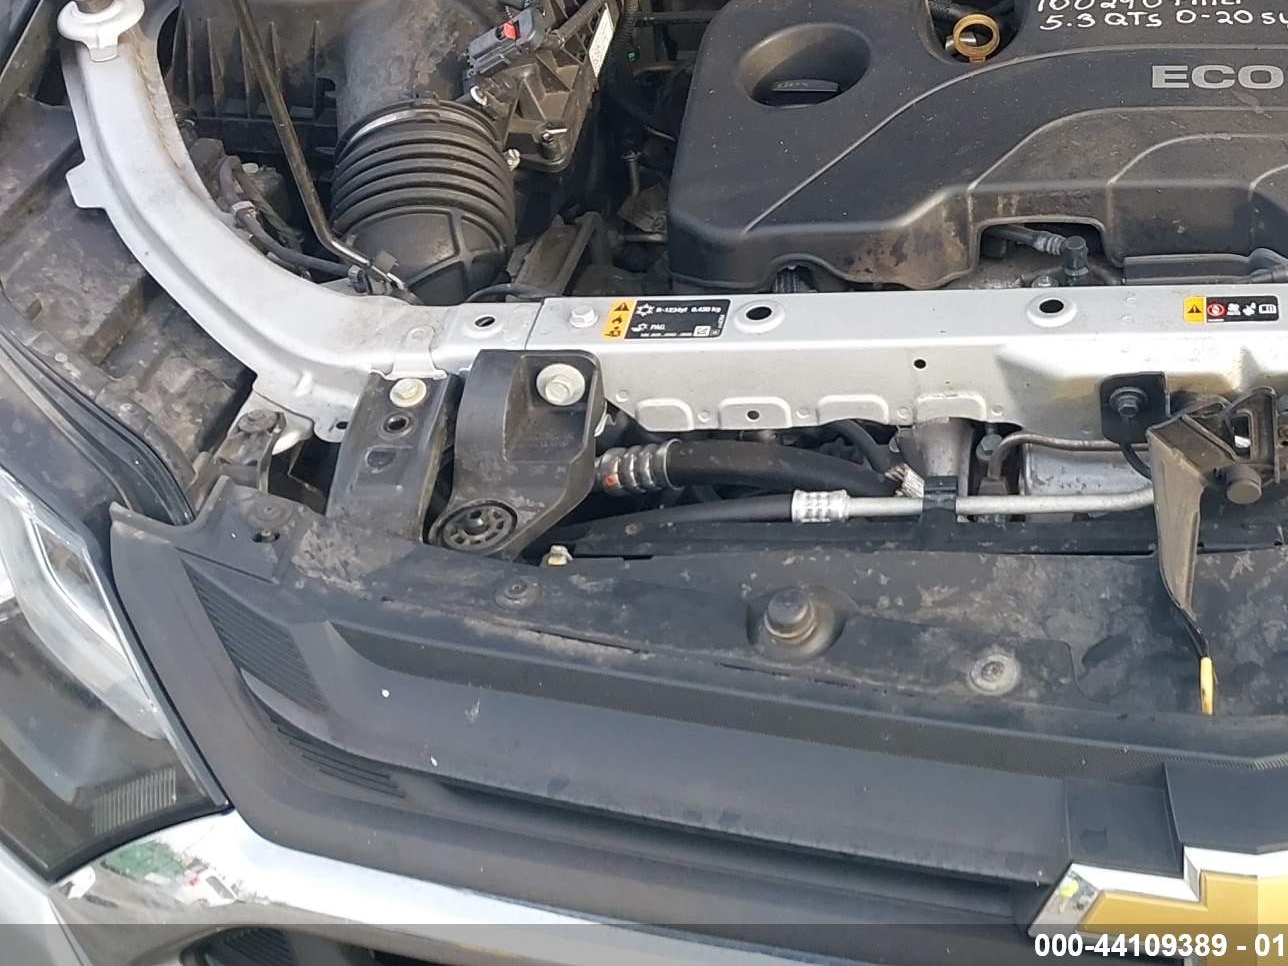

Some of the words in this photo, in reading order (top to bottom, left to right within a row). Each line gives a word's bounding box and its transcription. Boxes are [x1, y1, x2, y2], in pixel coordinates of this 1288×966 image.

[1039, 11, 1097, 31] 5.3
[1175, 9, 1254, 25] 0-20
[711, 306, 722, 314] kg
